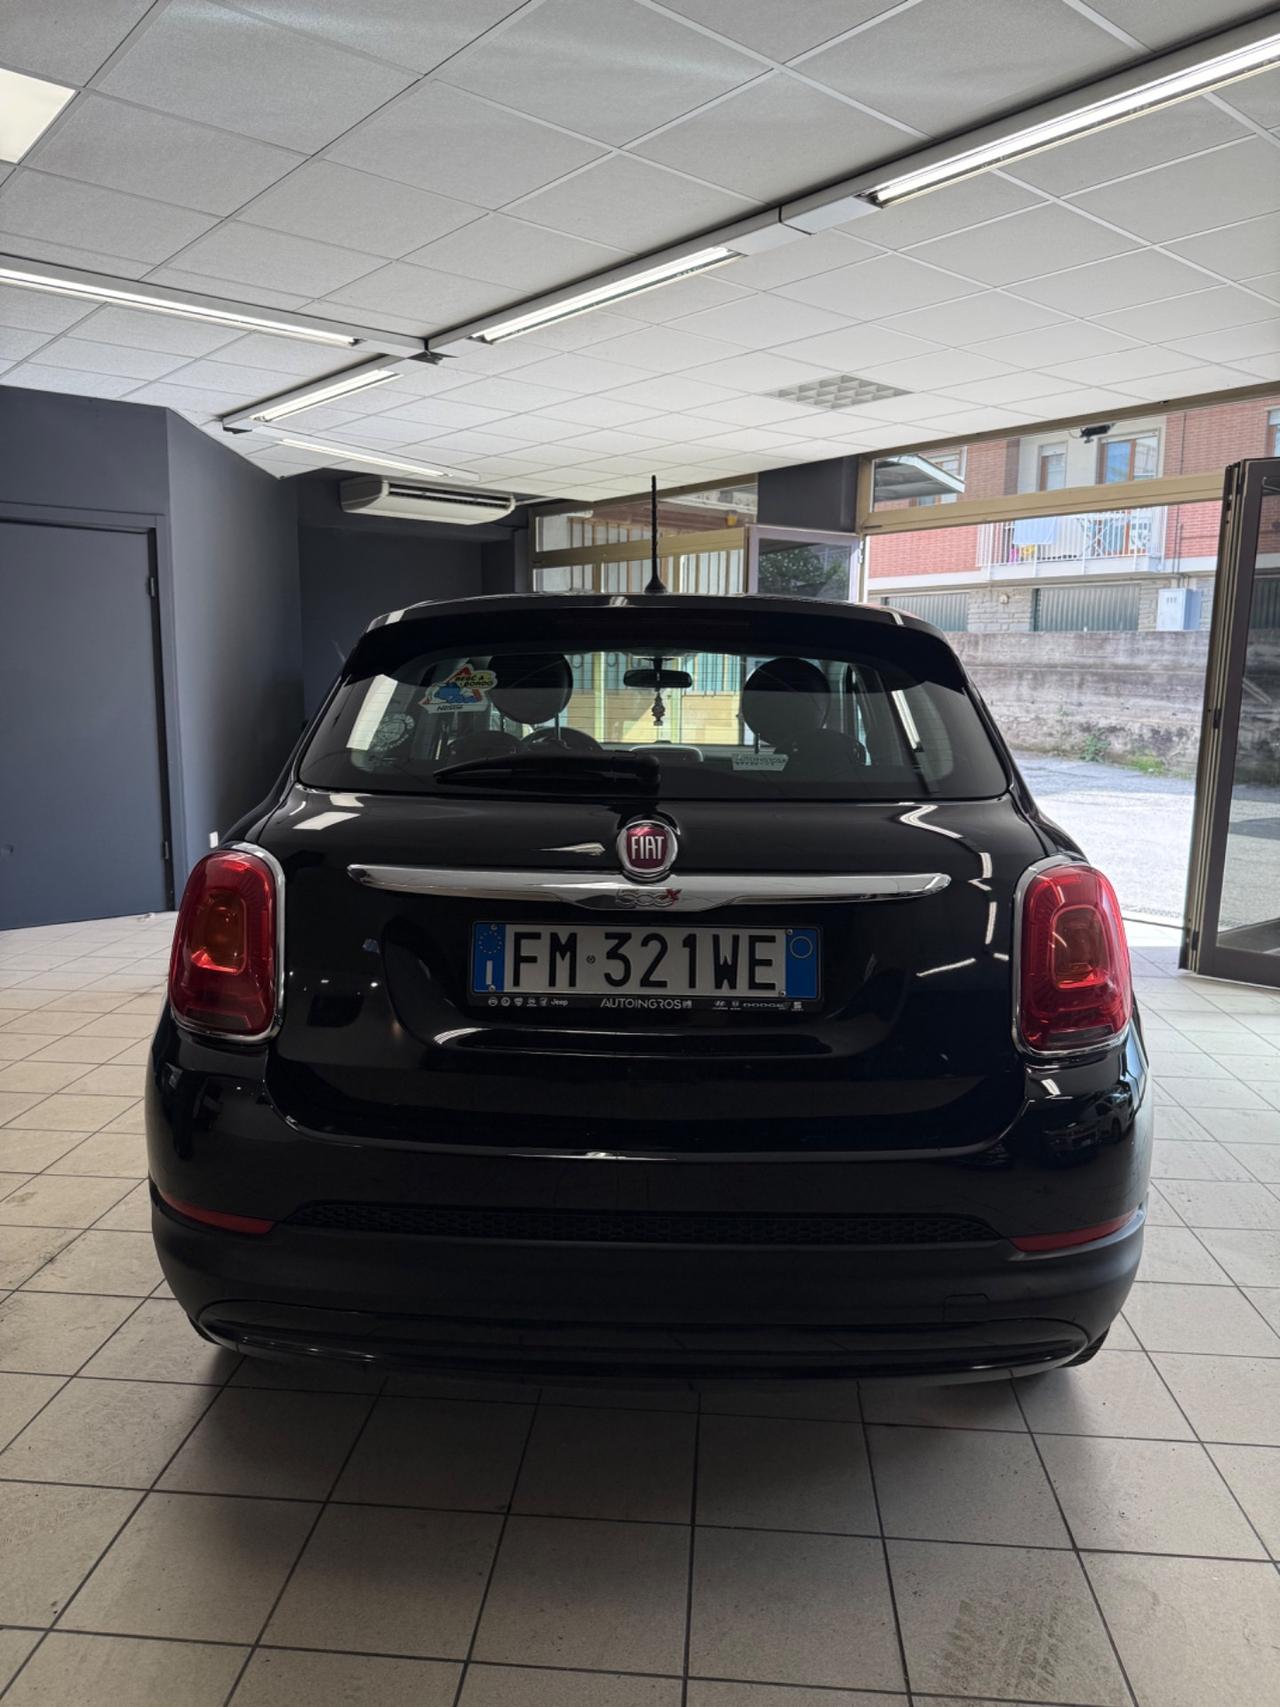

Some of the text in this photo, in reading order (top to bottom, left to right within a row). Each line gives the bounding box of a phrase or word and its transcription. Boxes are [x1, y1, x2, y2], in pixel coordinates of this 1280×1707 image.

[631, 836, 665, 860] FIAT
[512, 931, 579, 988] FM
[550, 998, 569, 1007] Jeep
[600, 998, 682, 1009] AUTOINGROS
